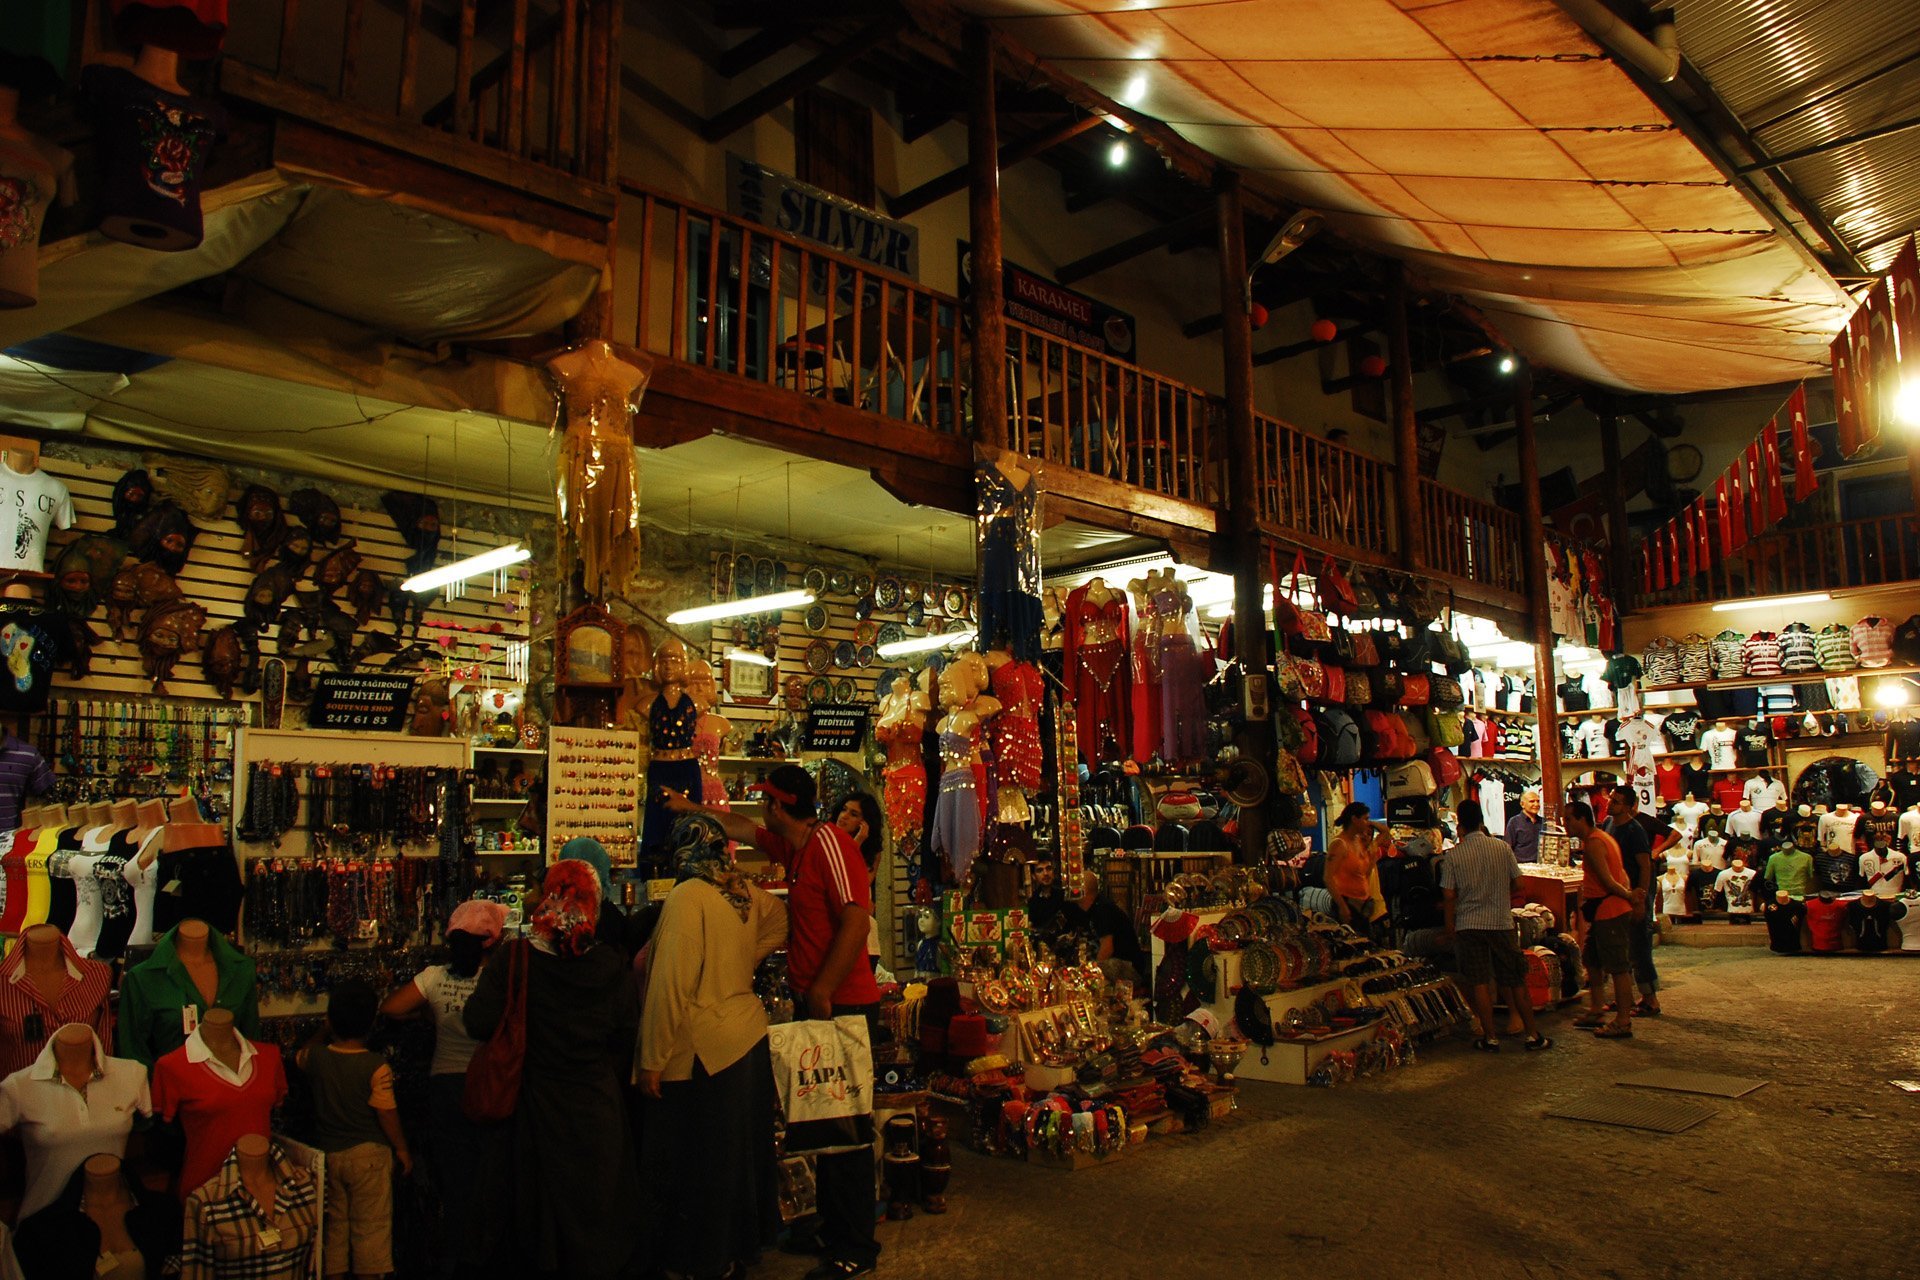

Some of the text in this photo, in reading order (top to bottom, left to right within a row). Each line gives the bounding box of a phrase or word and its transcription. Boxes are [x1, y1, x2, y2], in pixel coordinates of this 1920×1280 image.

[776, 188, 910, 274] SILVER
[1018, 278, 1089, 322] KARAMEL
[323, 678, 408, 689] GÜNGÖR SAĞIROĞLU
[333, 689, 394, 701] HEDİYELİK
[325, 703, 394, 713] SOUVENIR SHOP
[326, 714, 389, 725] 247 61 83
[818, 718, 854, 726] HEDİYELİK
[1640, 789, 1651, 806] 9
[797, 1066, 847, 1087] LAPA
